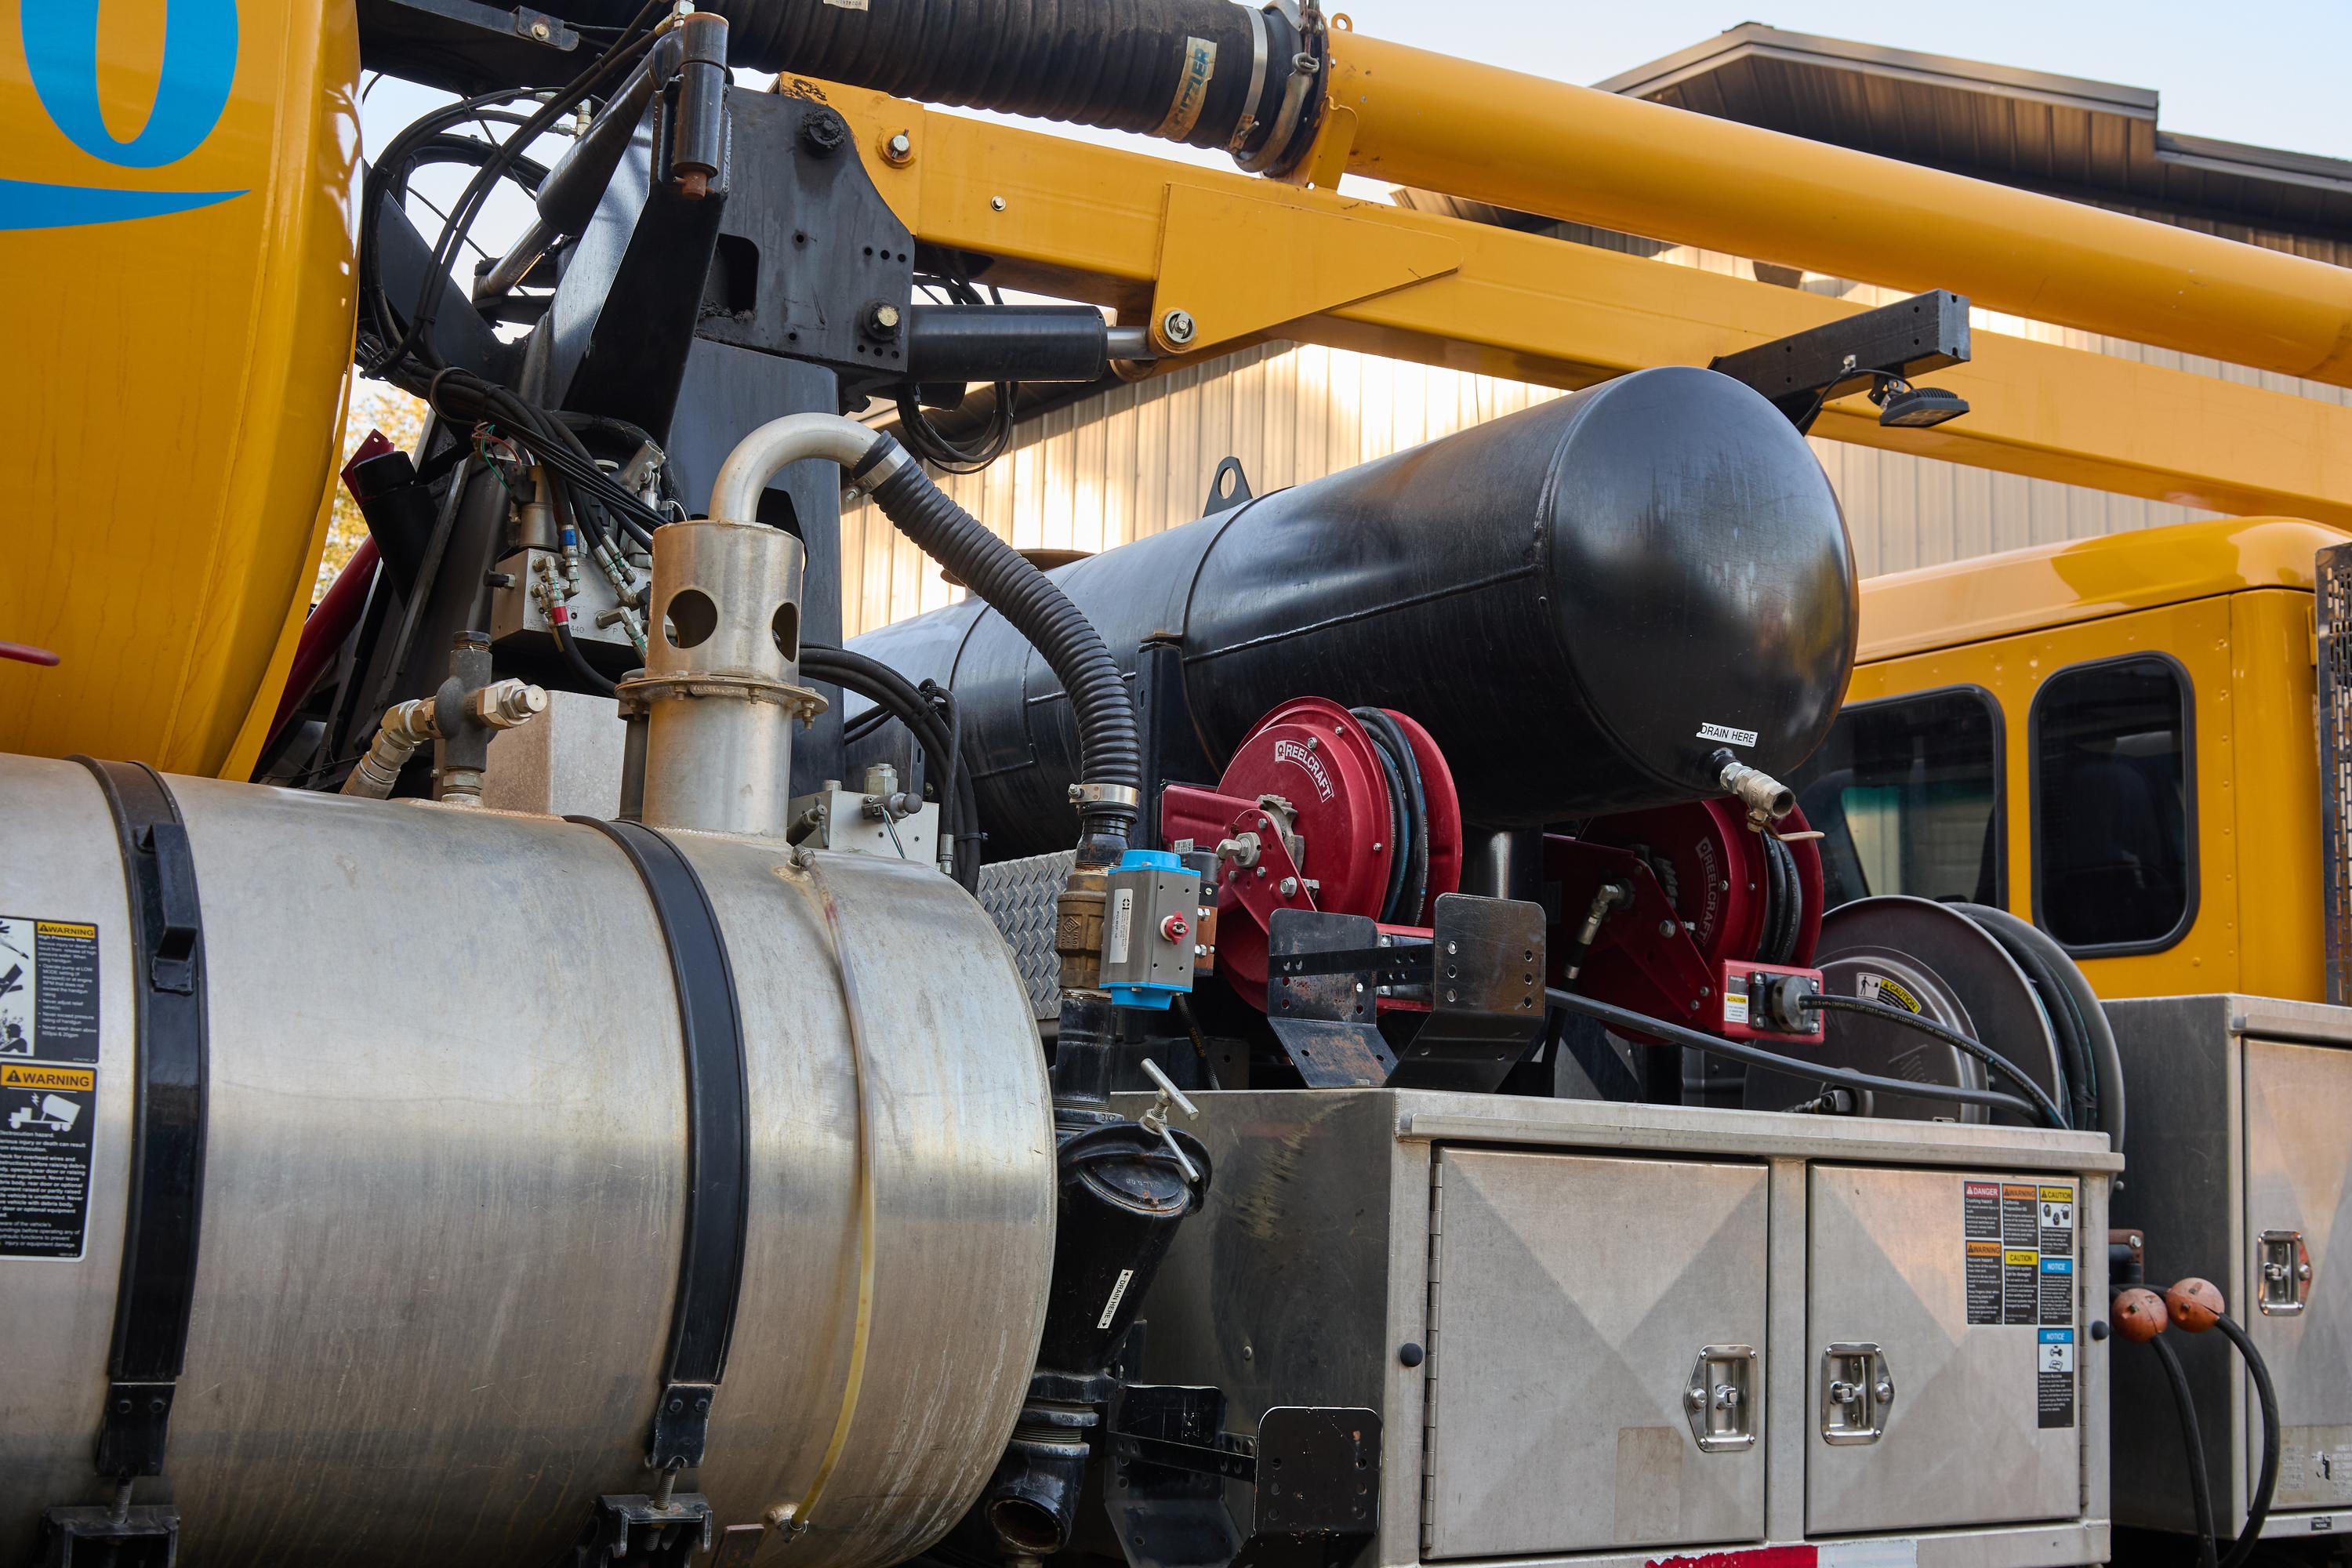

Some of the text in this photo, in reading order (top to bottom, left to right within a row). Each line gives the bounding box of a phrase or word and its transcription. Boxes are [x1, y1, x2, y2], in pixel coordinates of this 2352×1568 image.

[1700, 724, 1755, 743] DRAIN HERE
[1286, 744, 1330, 797] REELCRAFT
[1702, 853, 1717, 942] REELCRAFT
[49, 927, 93, 936] WARNING
[1889, 984, 1917, 1009] CAUTION
[23, 1073, 90, 1087] WARNING
[1104, 1279, 1126, 1319] DRAIN HERE
